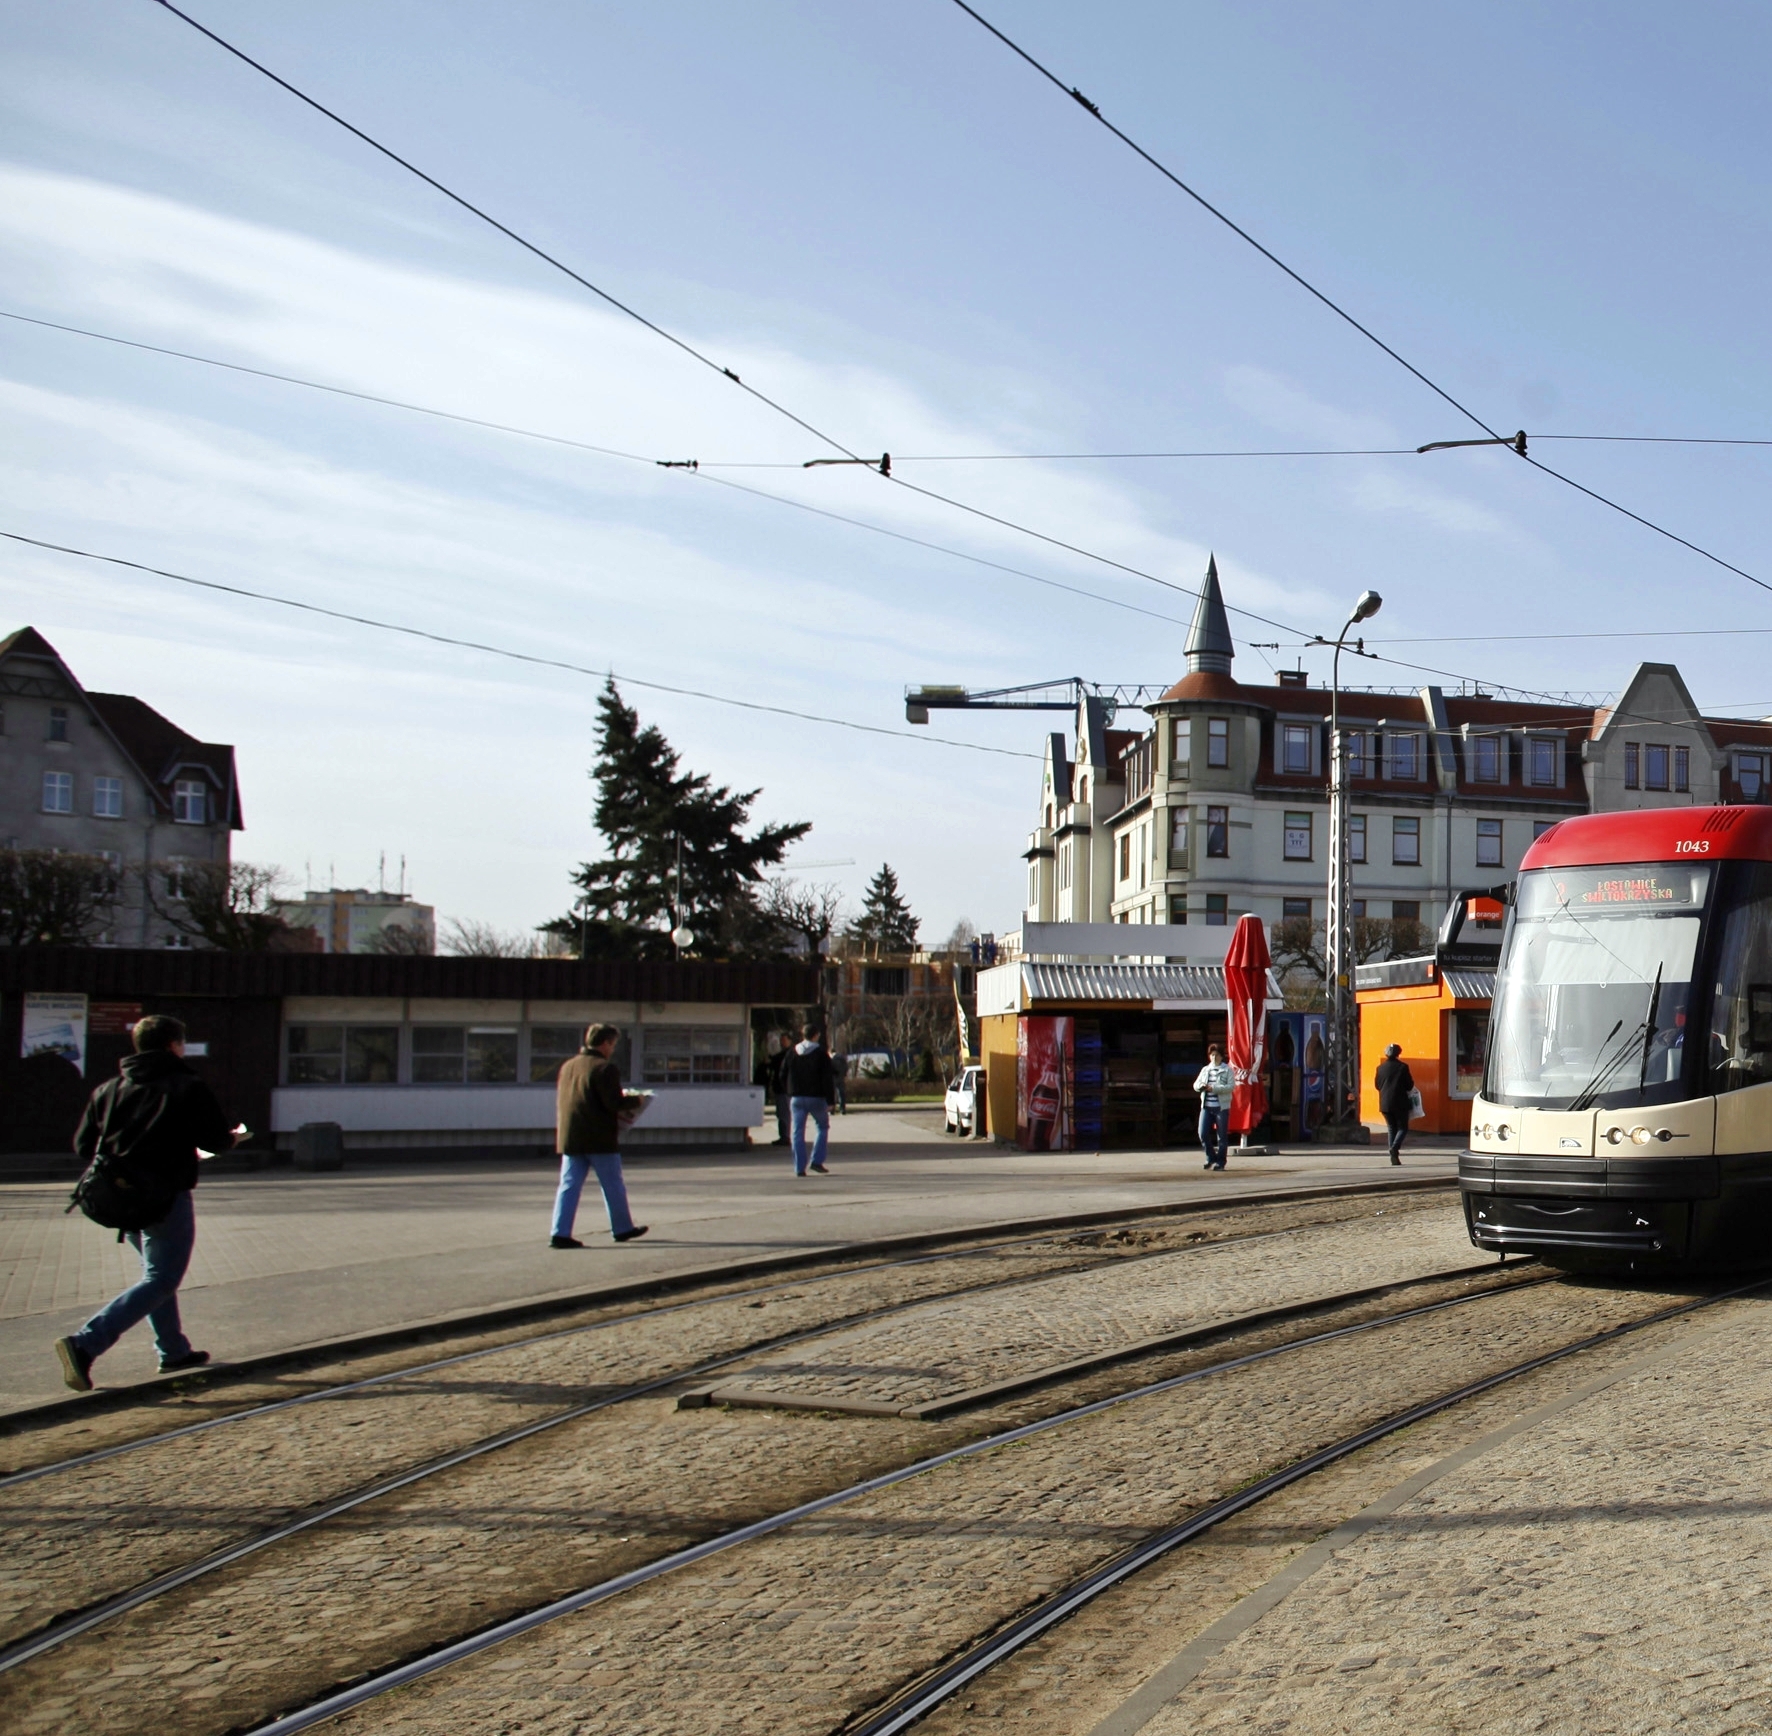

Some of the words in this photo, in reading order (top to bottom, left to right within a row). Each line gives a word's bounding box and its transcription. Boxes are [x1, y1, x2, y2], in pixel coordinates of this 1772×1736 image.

[1675, 841, 1709, 853] 1043
[1555, 882, 1567, 904] 2
[1476, 911, 1500, 919] orange
